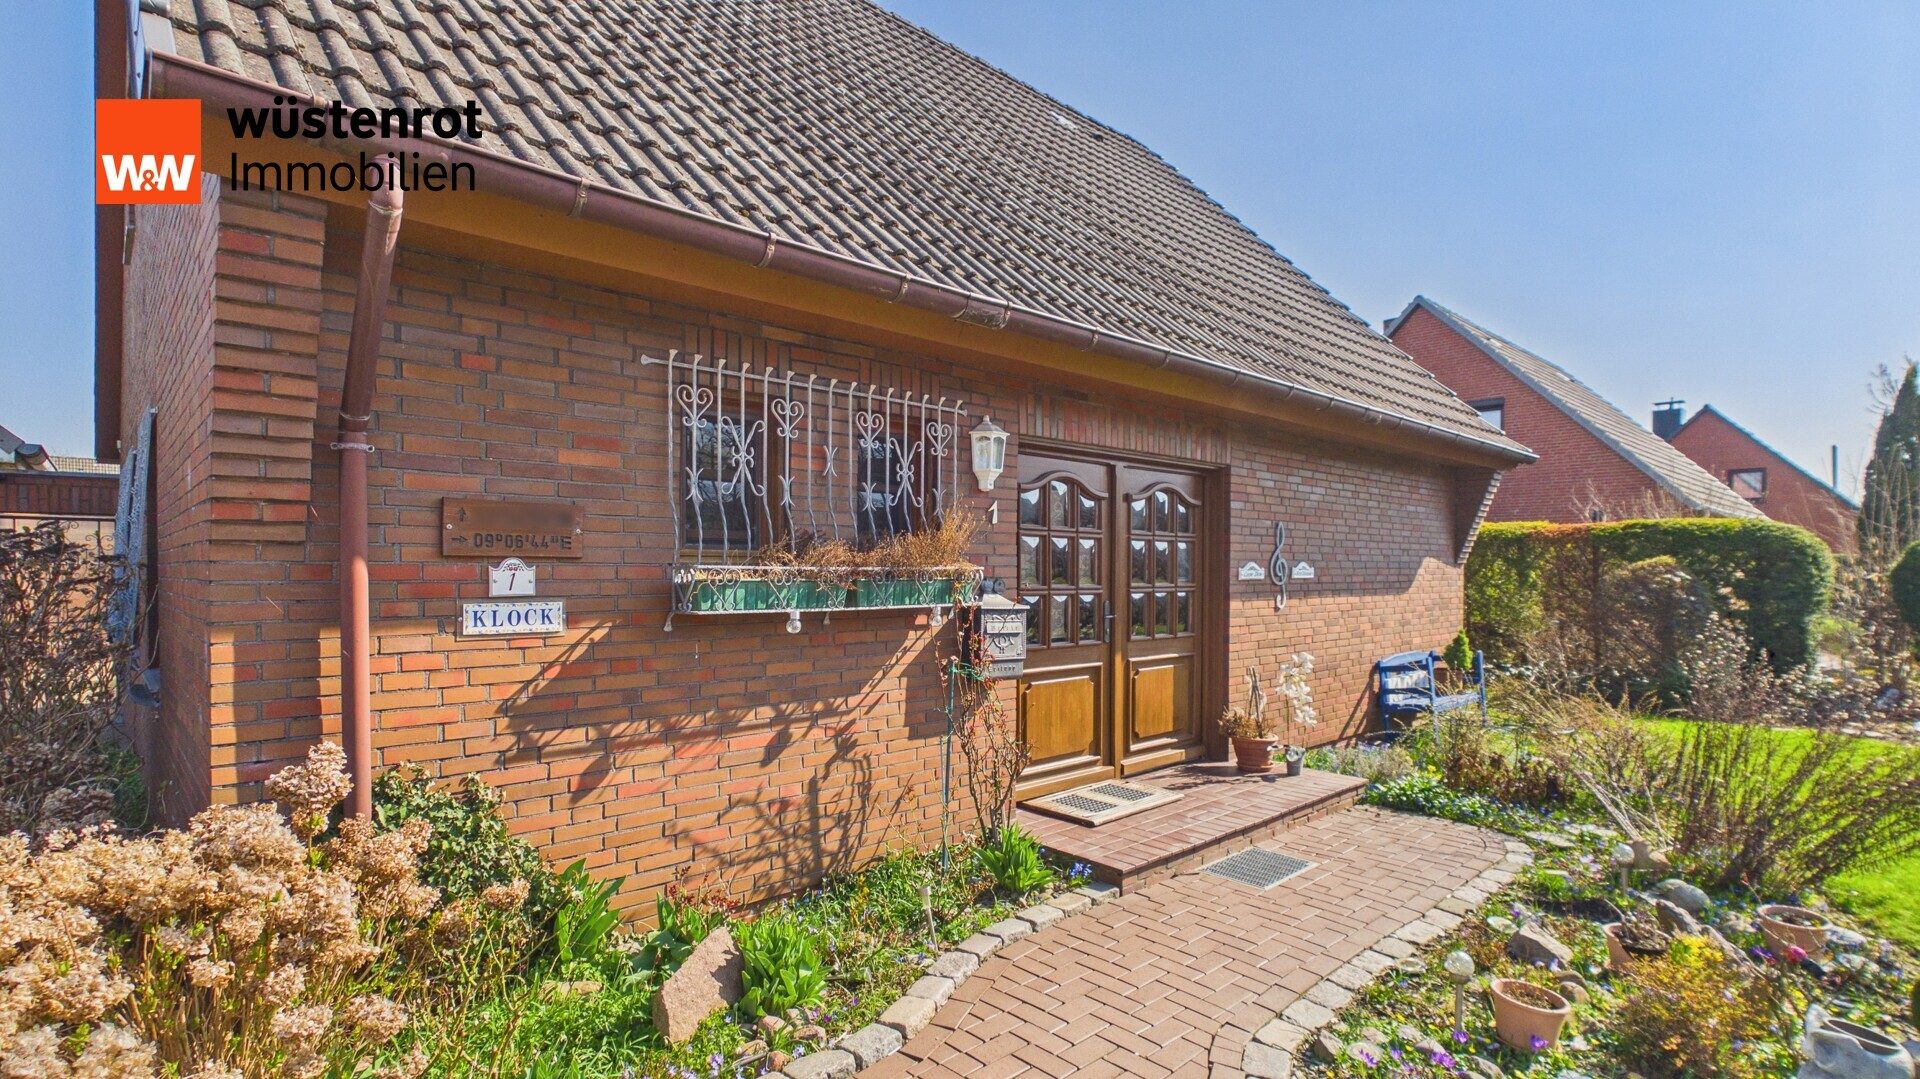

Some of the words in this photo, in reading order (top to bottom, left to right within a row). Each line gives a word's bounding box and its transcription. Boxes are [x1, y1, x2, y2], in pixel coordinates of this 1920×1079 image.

[988, 500, 998, 525] 1
[508, 572, 517, 592] 1
[472, 608, 554, 628] KLOCK
